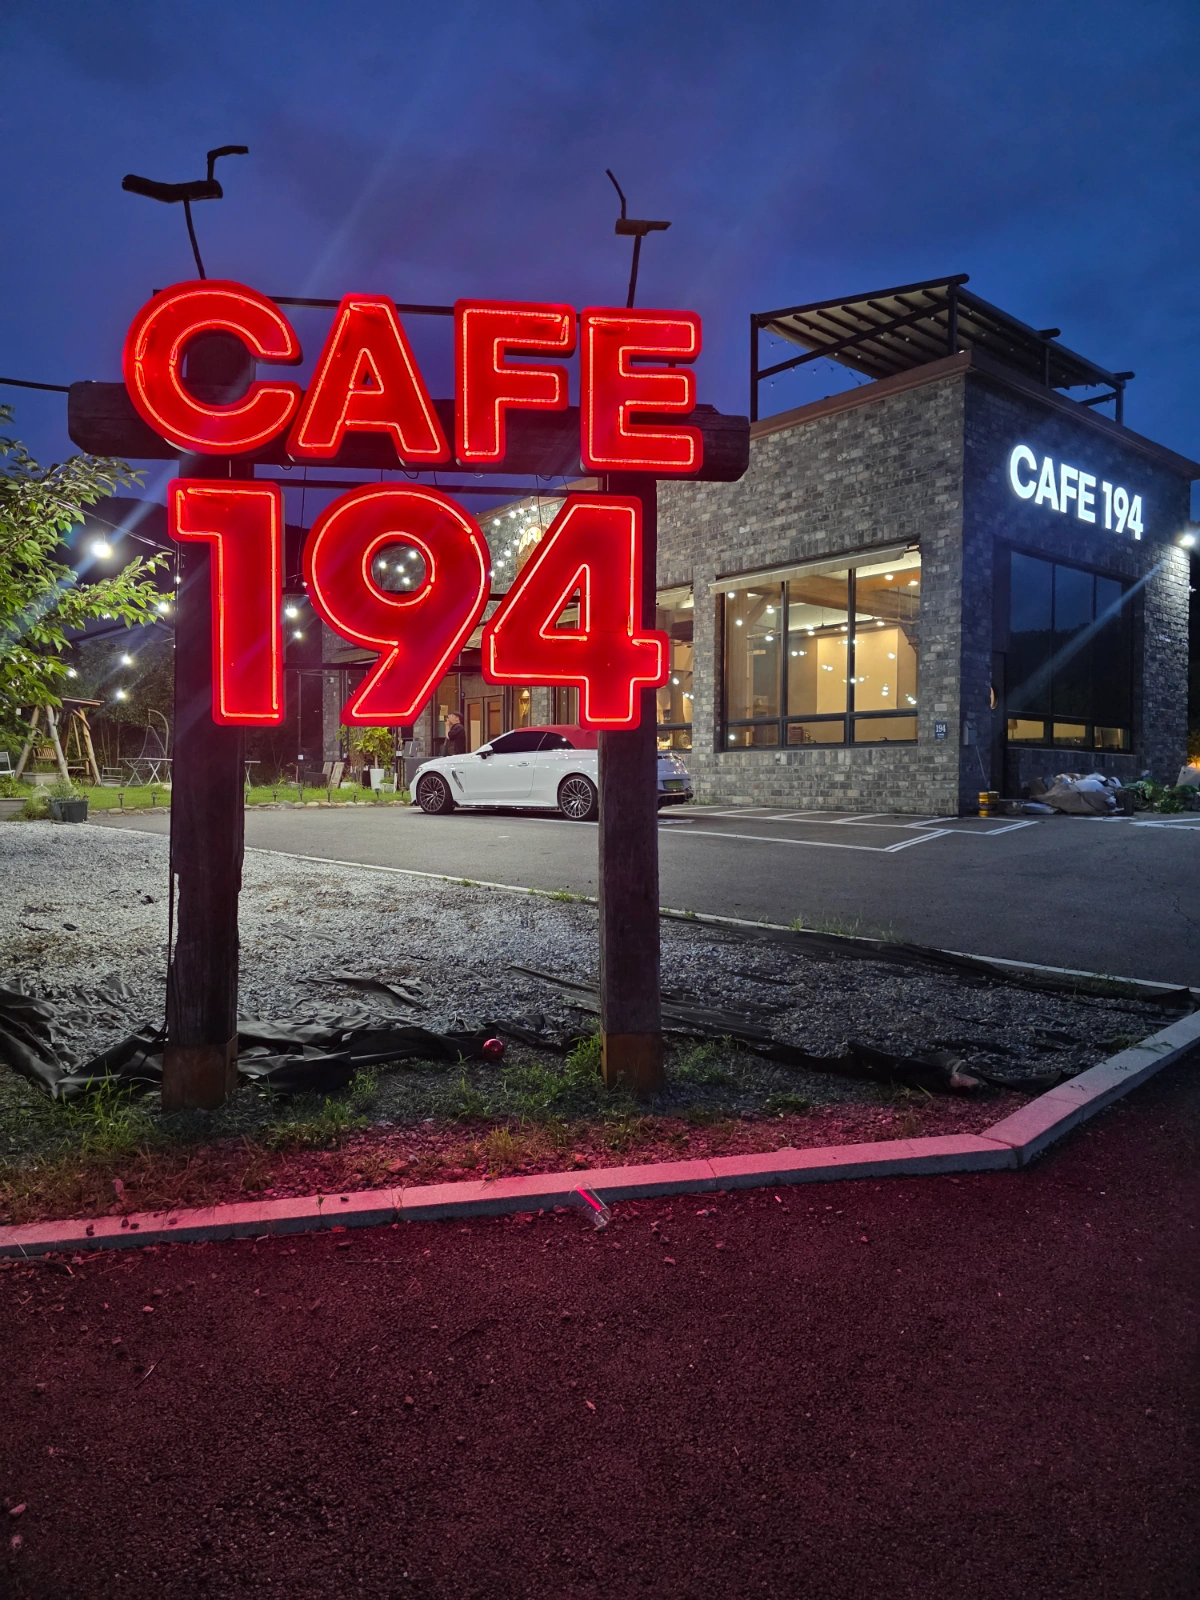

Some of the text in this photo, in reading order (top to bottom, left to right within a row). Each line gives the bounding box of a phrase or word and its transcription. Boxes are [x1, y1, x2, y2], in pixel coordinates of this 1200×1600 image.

[123, 279, 703, 473] CAFE
[1010, 445, 1144, 541] CAFE 194
[168, 478, 669, 730] 194
[935, 724, 946, 733] 194
